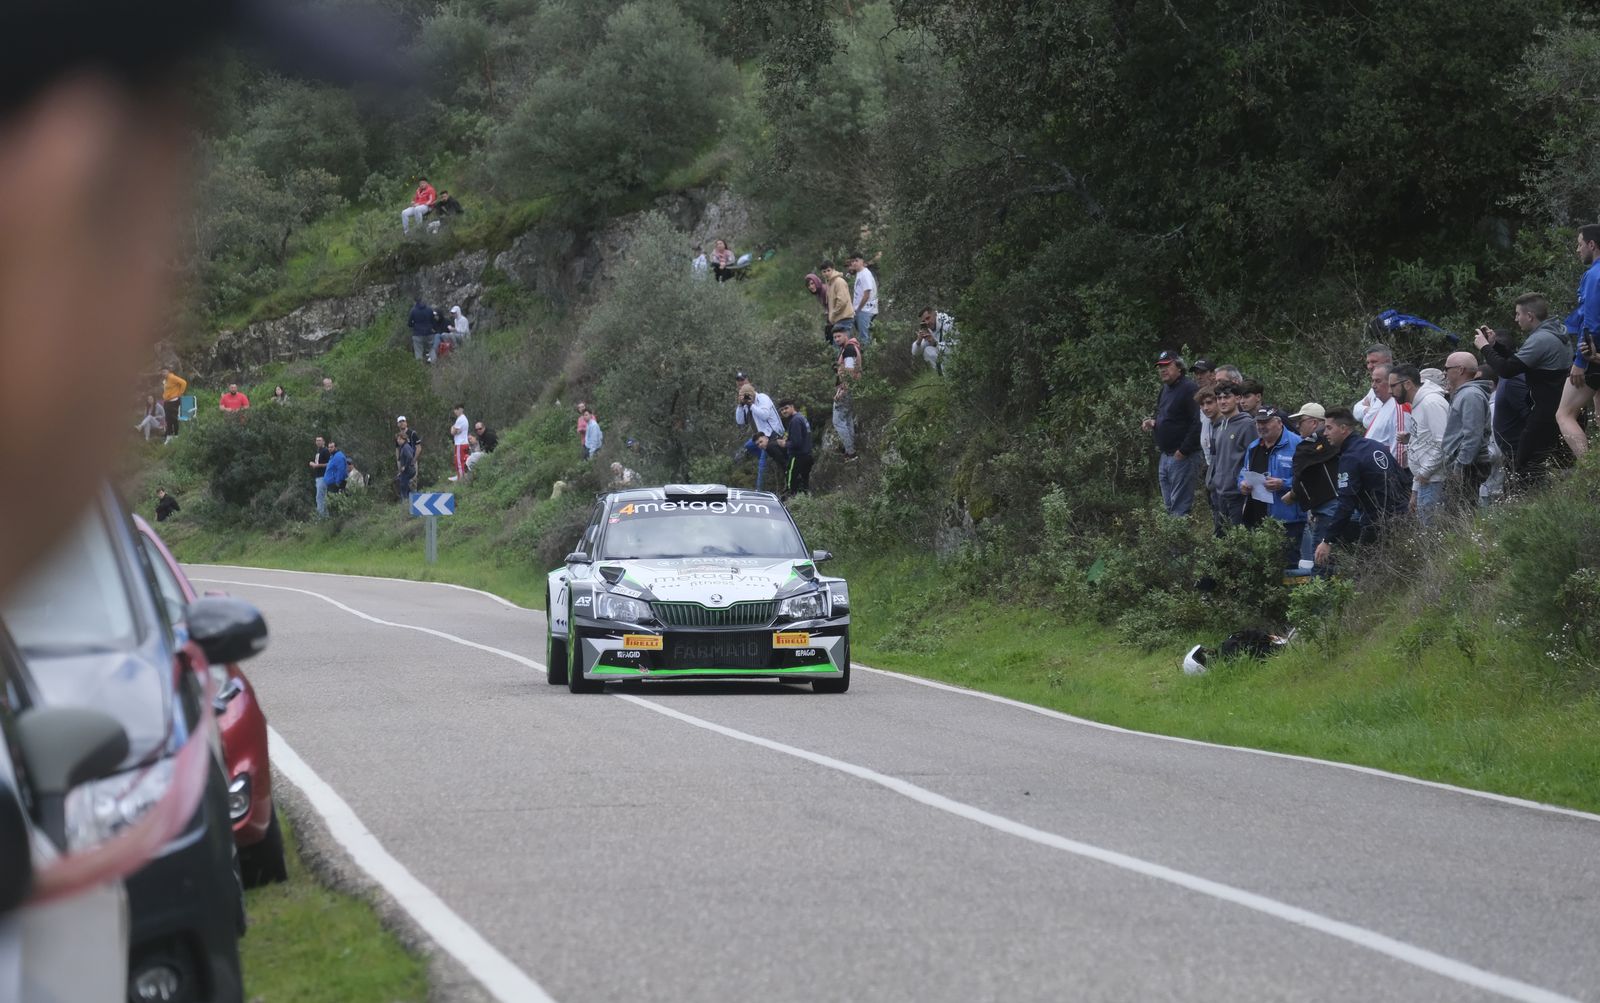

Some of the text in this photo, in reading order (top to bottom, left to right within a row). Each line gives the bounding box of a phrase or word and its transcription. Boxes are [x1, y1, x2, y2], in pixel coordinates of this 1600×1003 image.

[620, 503, 635, 515] 4
[635, 500, 770, 514] metagym
[655, 573, 770, 582] metagym
[625, 636, 659, 647] PIRELLI
[776, 635, 807, 644] PIRELLI
[674, 641, 758, 659] FARMA10
